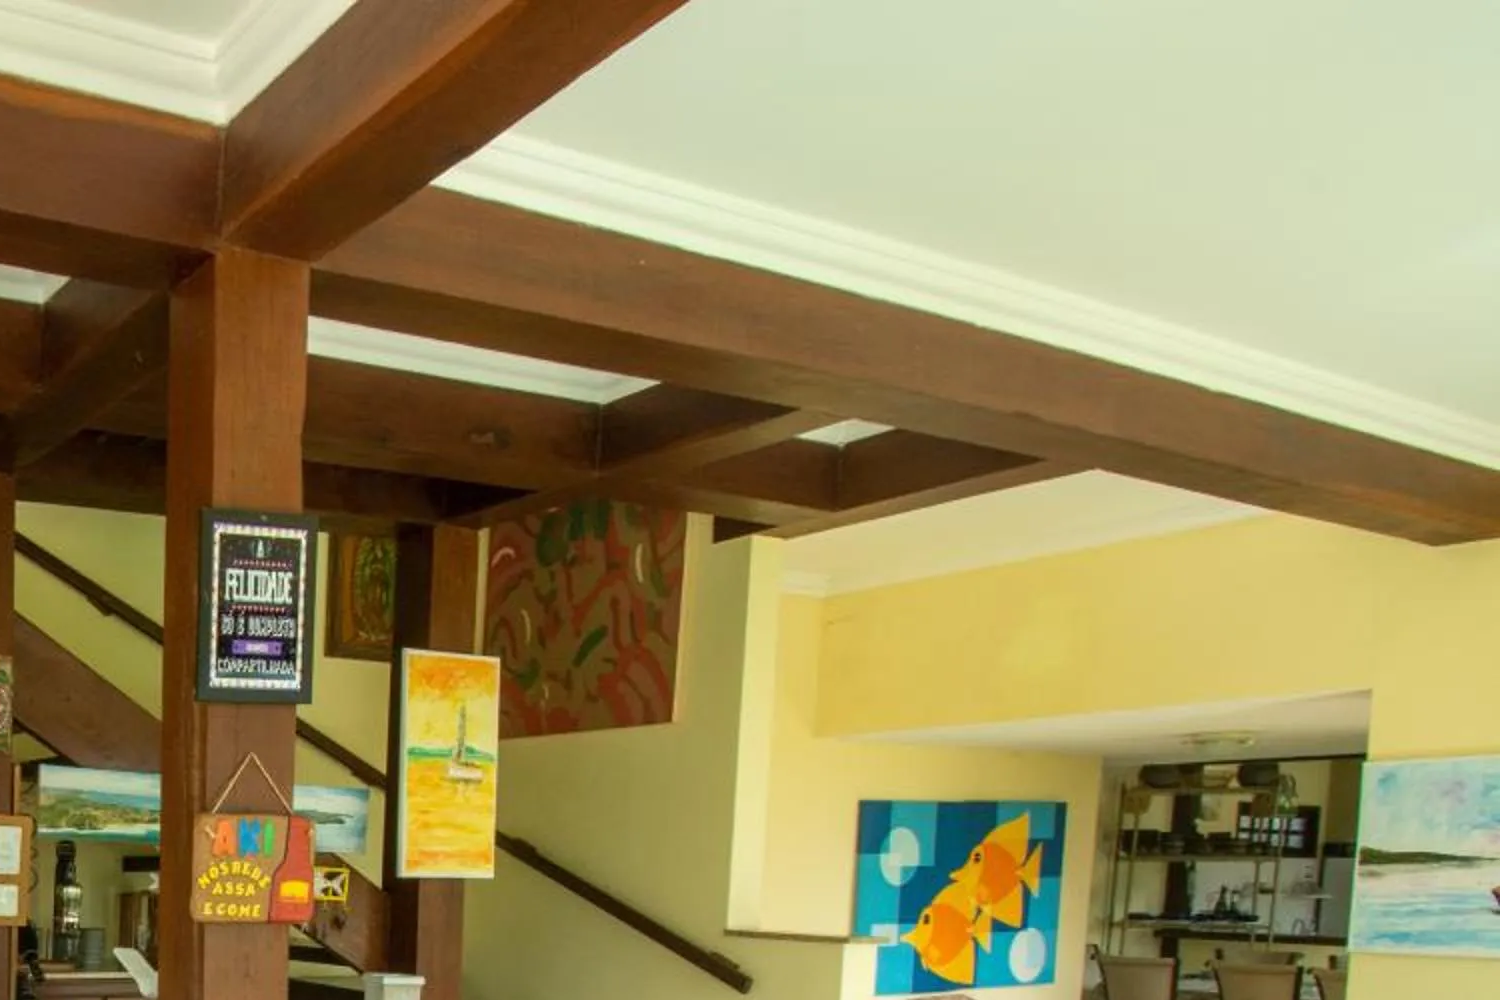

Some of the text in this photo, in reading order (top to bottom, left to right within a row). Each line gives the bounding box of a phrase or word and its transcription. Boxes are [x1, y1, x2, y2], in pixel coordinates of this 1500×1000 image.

[225, 568, 293, 604] FELICIDADE
[212, 816, 275, 857] AKI
[212, 881, 256, 897] ASSA
[216, 903, 261, 918] COME
